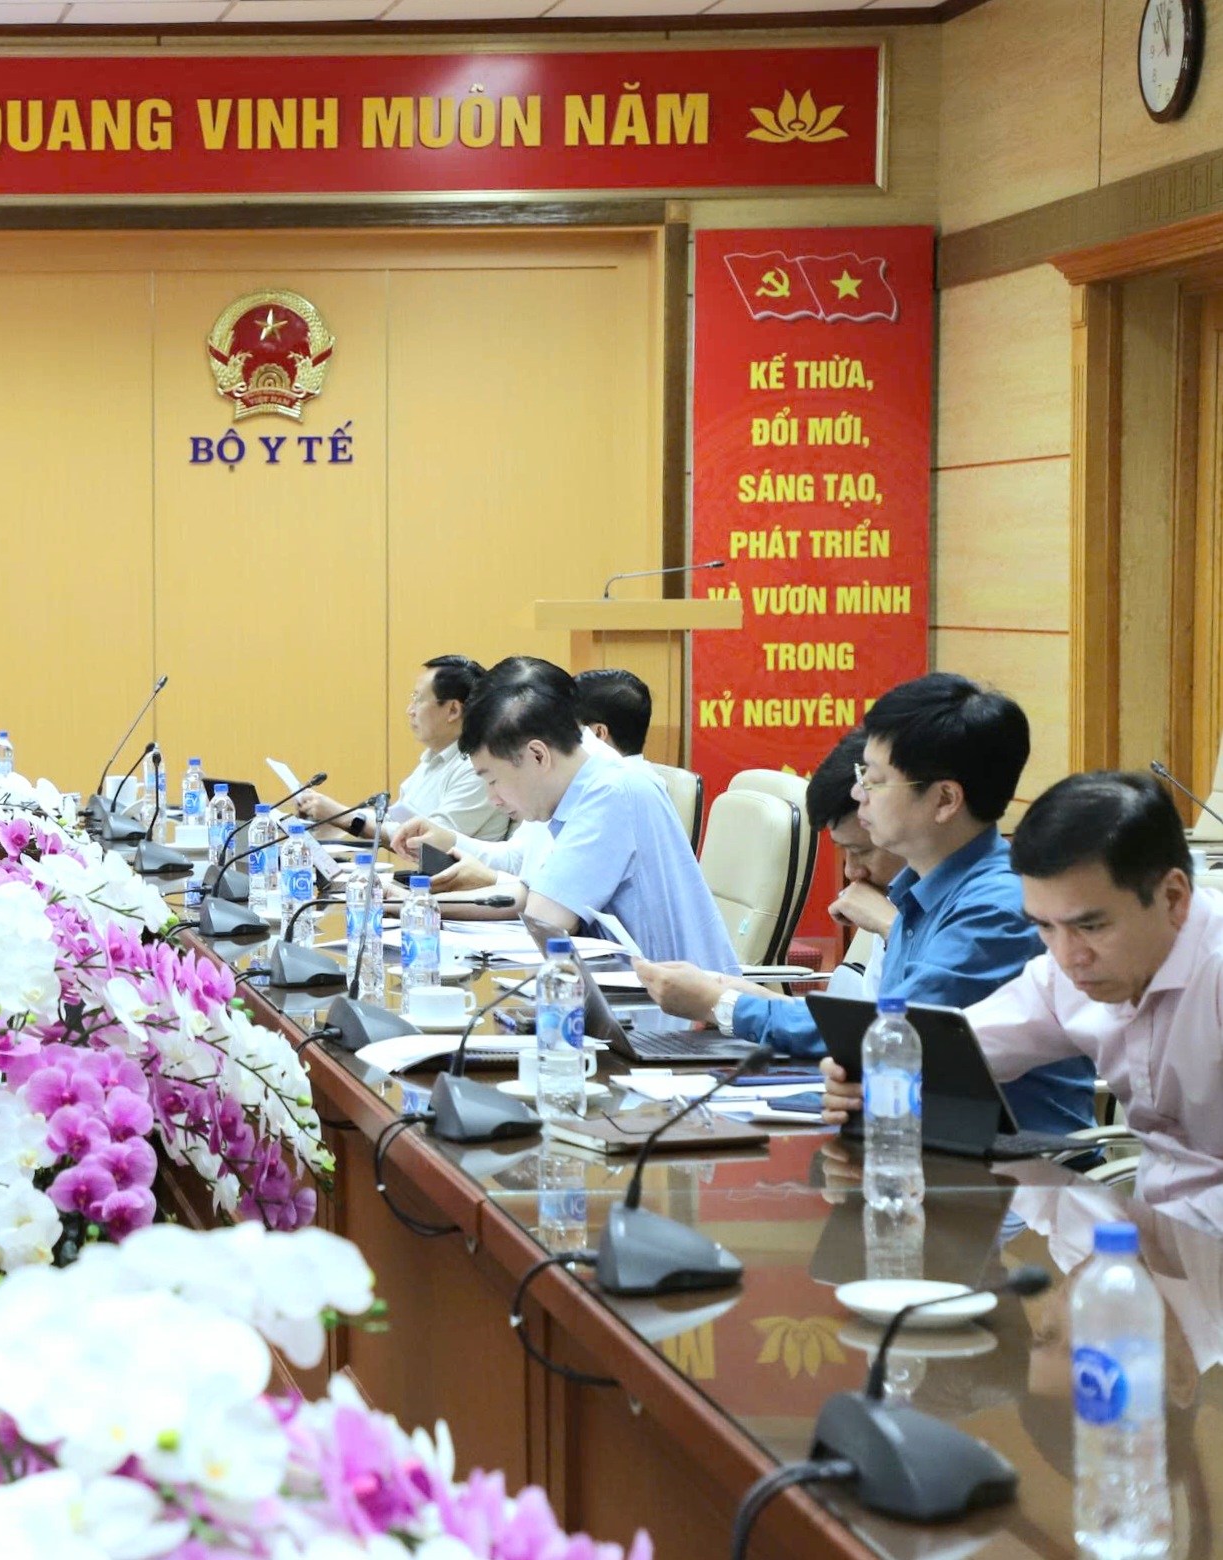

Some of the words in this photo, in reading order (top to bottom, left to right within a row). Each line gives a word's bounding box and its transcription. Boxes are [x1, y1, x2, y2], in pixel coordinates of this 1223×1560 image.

[197, 97, 338, 150] VINH
[362, 83, 541, 149] MUÔN
[564, 81, 709, 147] NĂM
[749, 352, 786, 390] KẾ
[793, 356, 874, 391] THỪA,
[189, 428, 246, 472] BỘ
[259, 436, 287, 464] Y
[297, 420, 353, 464] TẾ
[750, 406, 799, 447] ĐỔI
[807, 410, 870, 448] MỚI,
[737, 470, 815, 504] SÁNG
[822, 473, 883, 508] TẠO,
[729, 524, 801, 560] PHÁT
[808, 517, 890, 560] TRIỂN
[751, 583, 827, 616] VƯƠN
[835, 579, 911, 615] MÌNH
[762, 641, 855, 672] TRONG
[699, 689, 736, 729] KỶ
[743, 692, 856, 728] NGUYÊN
[293, 876, 311, 890] ICY
[568, 1015, 584, 1035] IC
[1074, 1361, 1119, 1401] CY
